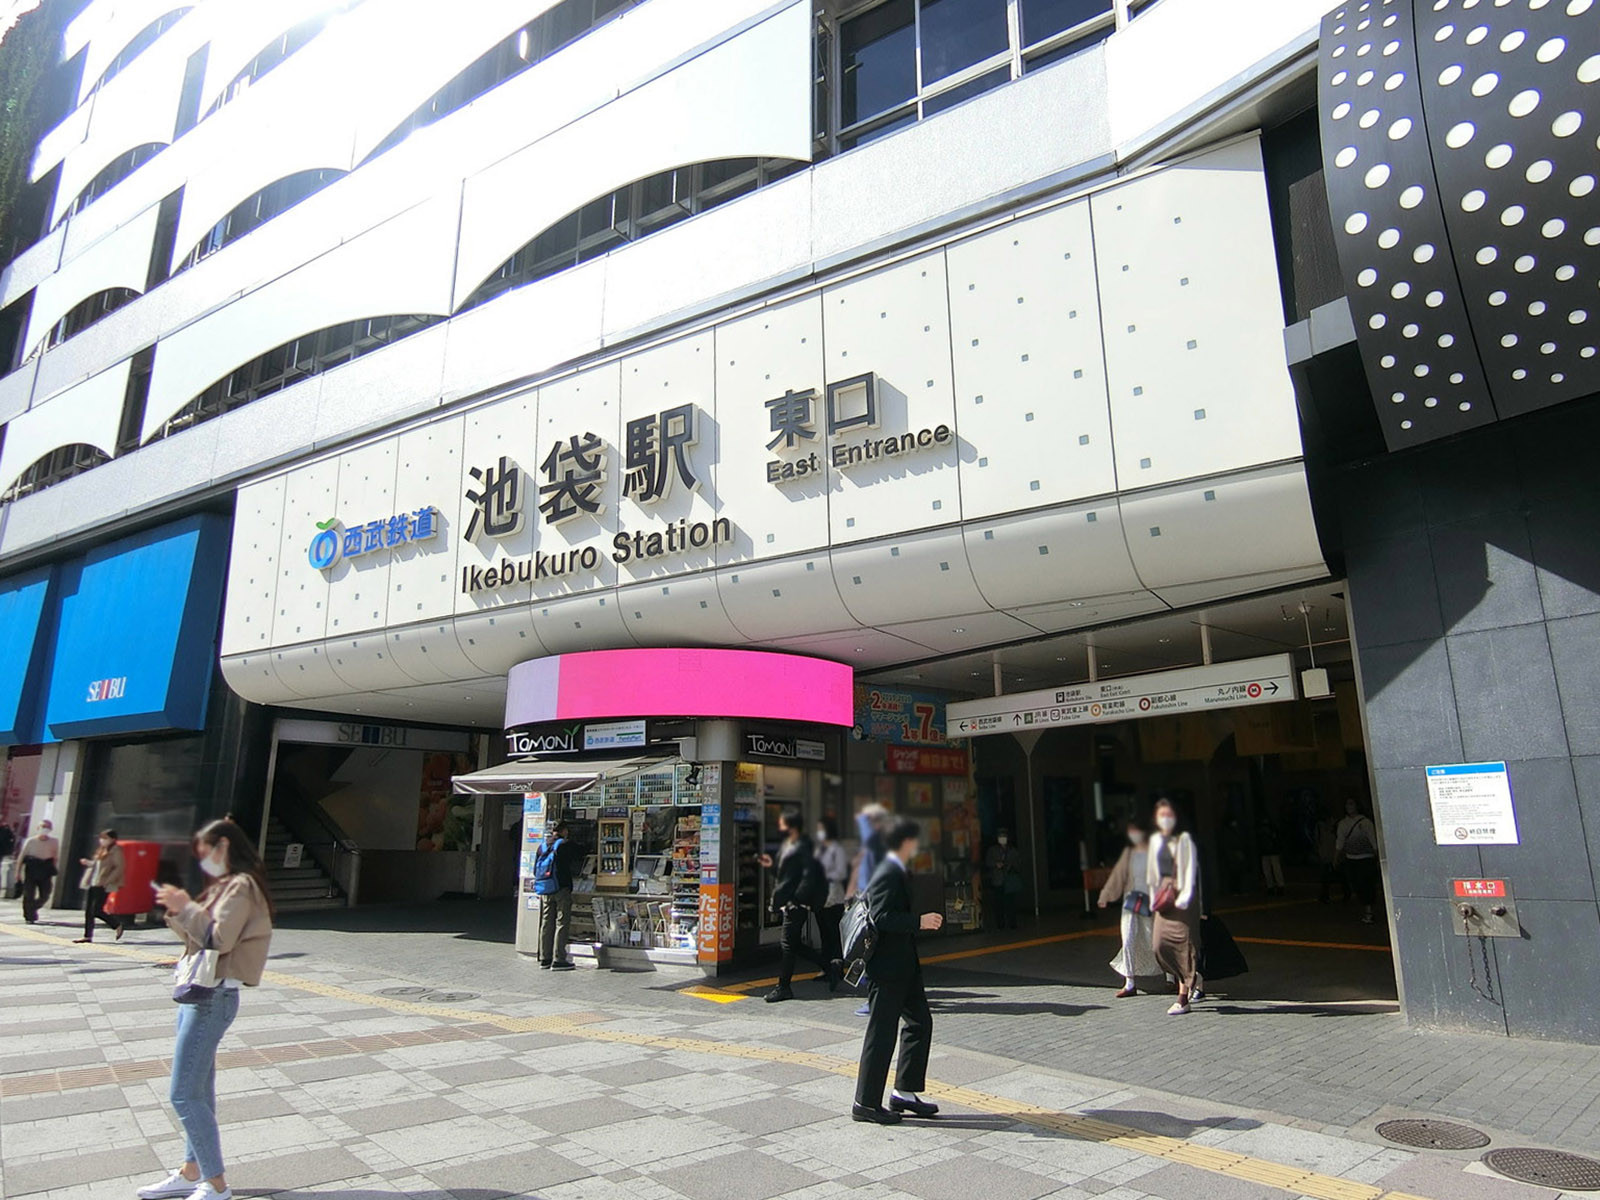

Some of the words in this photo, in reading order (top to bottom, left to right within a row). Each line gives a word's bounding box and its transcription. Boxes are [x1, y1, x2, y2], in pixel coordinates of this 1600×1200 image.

[765, 371, 876, 452] 東口
[463, 402, 699, 543] 池袋駅
[766, 452, 819, 484] East
[831, 424, 951, 468] Entrance
[343, 505, 436, 558] 西武鉄道
[461, 545, 598, 594] Ikebukuro
[612, 516, 731, 563] Station
[86, 676, 128, 703] SEIBU
[337, 724, 407, 746] SEIBU
[700, 894, 717, 952] たばこ
[720, 893, 733, 952] たばこ
